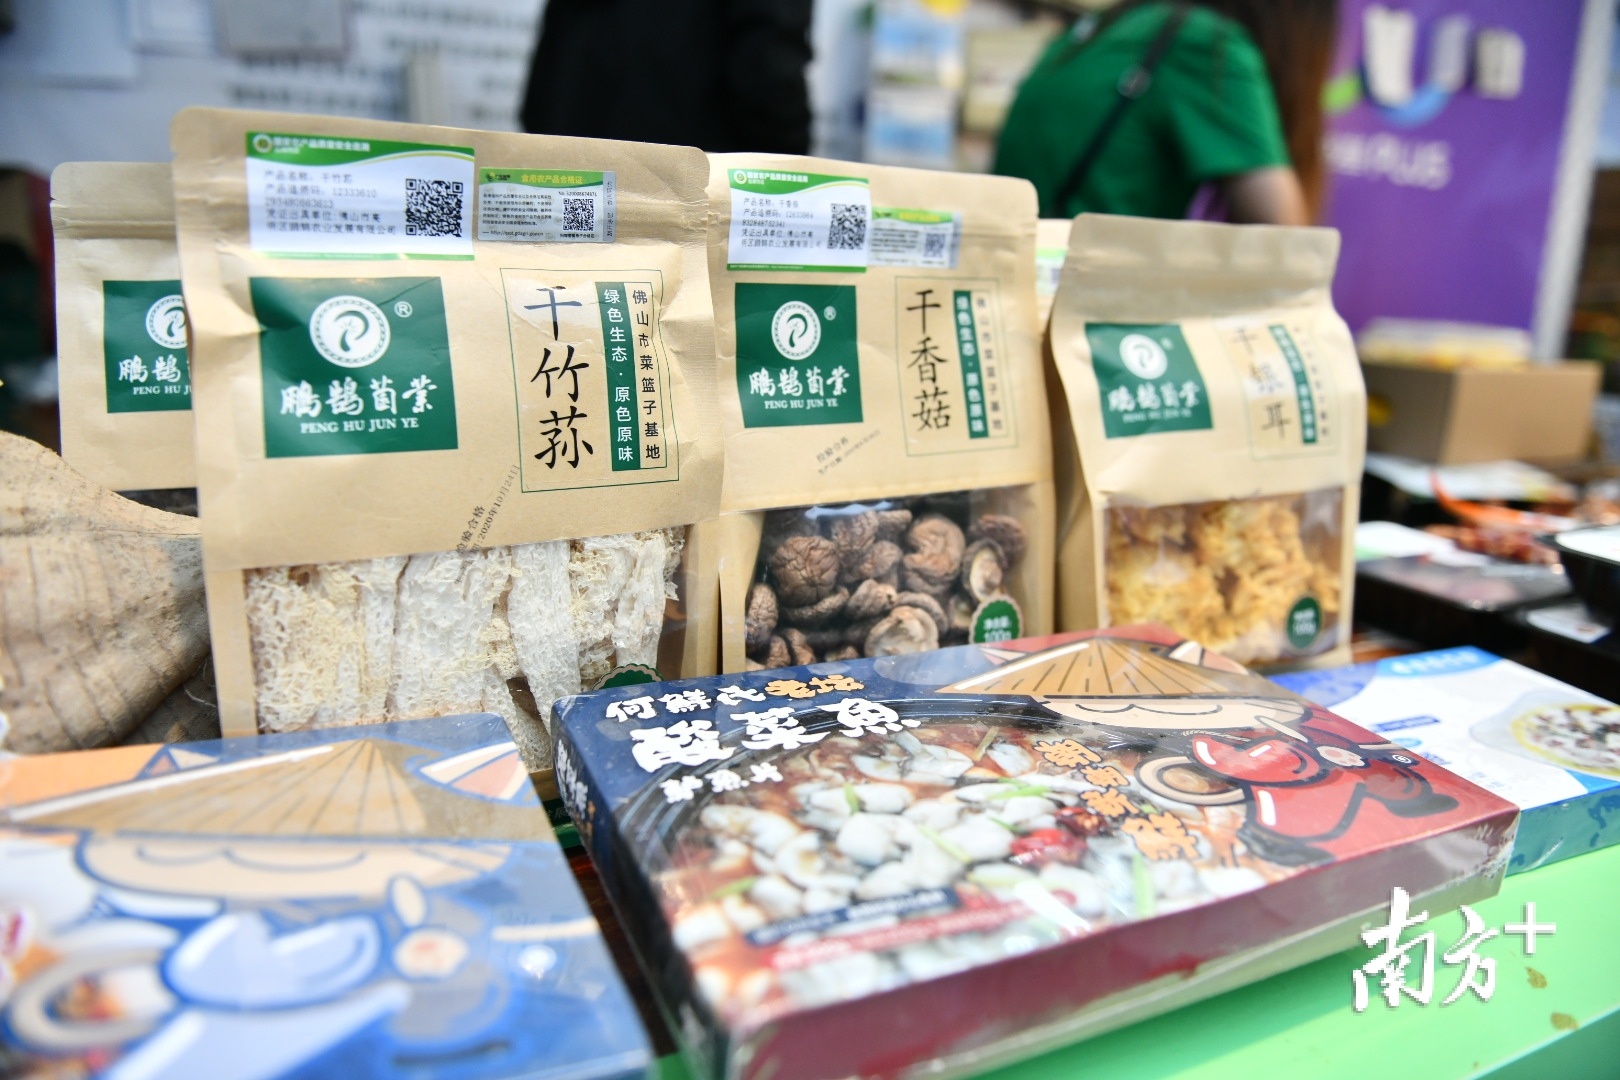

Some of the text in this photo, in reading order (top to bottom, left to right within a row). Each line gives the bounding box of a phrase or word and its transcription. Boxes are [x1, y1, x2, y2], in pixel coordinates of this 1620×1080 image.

[133, 386, 160, 395] PENG
[164, 385, 181, 394] HU
[523, 285, 594, 469] 干竹荪
[632, 289, 661, 460] 佛山市菜篮子基地
[906, 289, 950, 432] 干香菇
[301, 417, 419, 434] PENG HU JUN YE
[765, 398, 838, 409] PENG HU JUN YE
